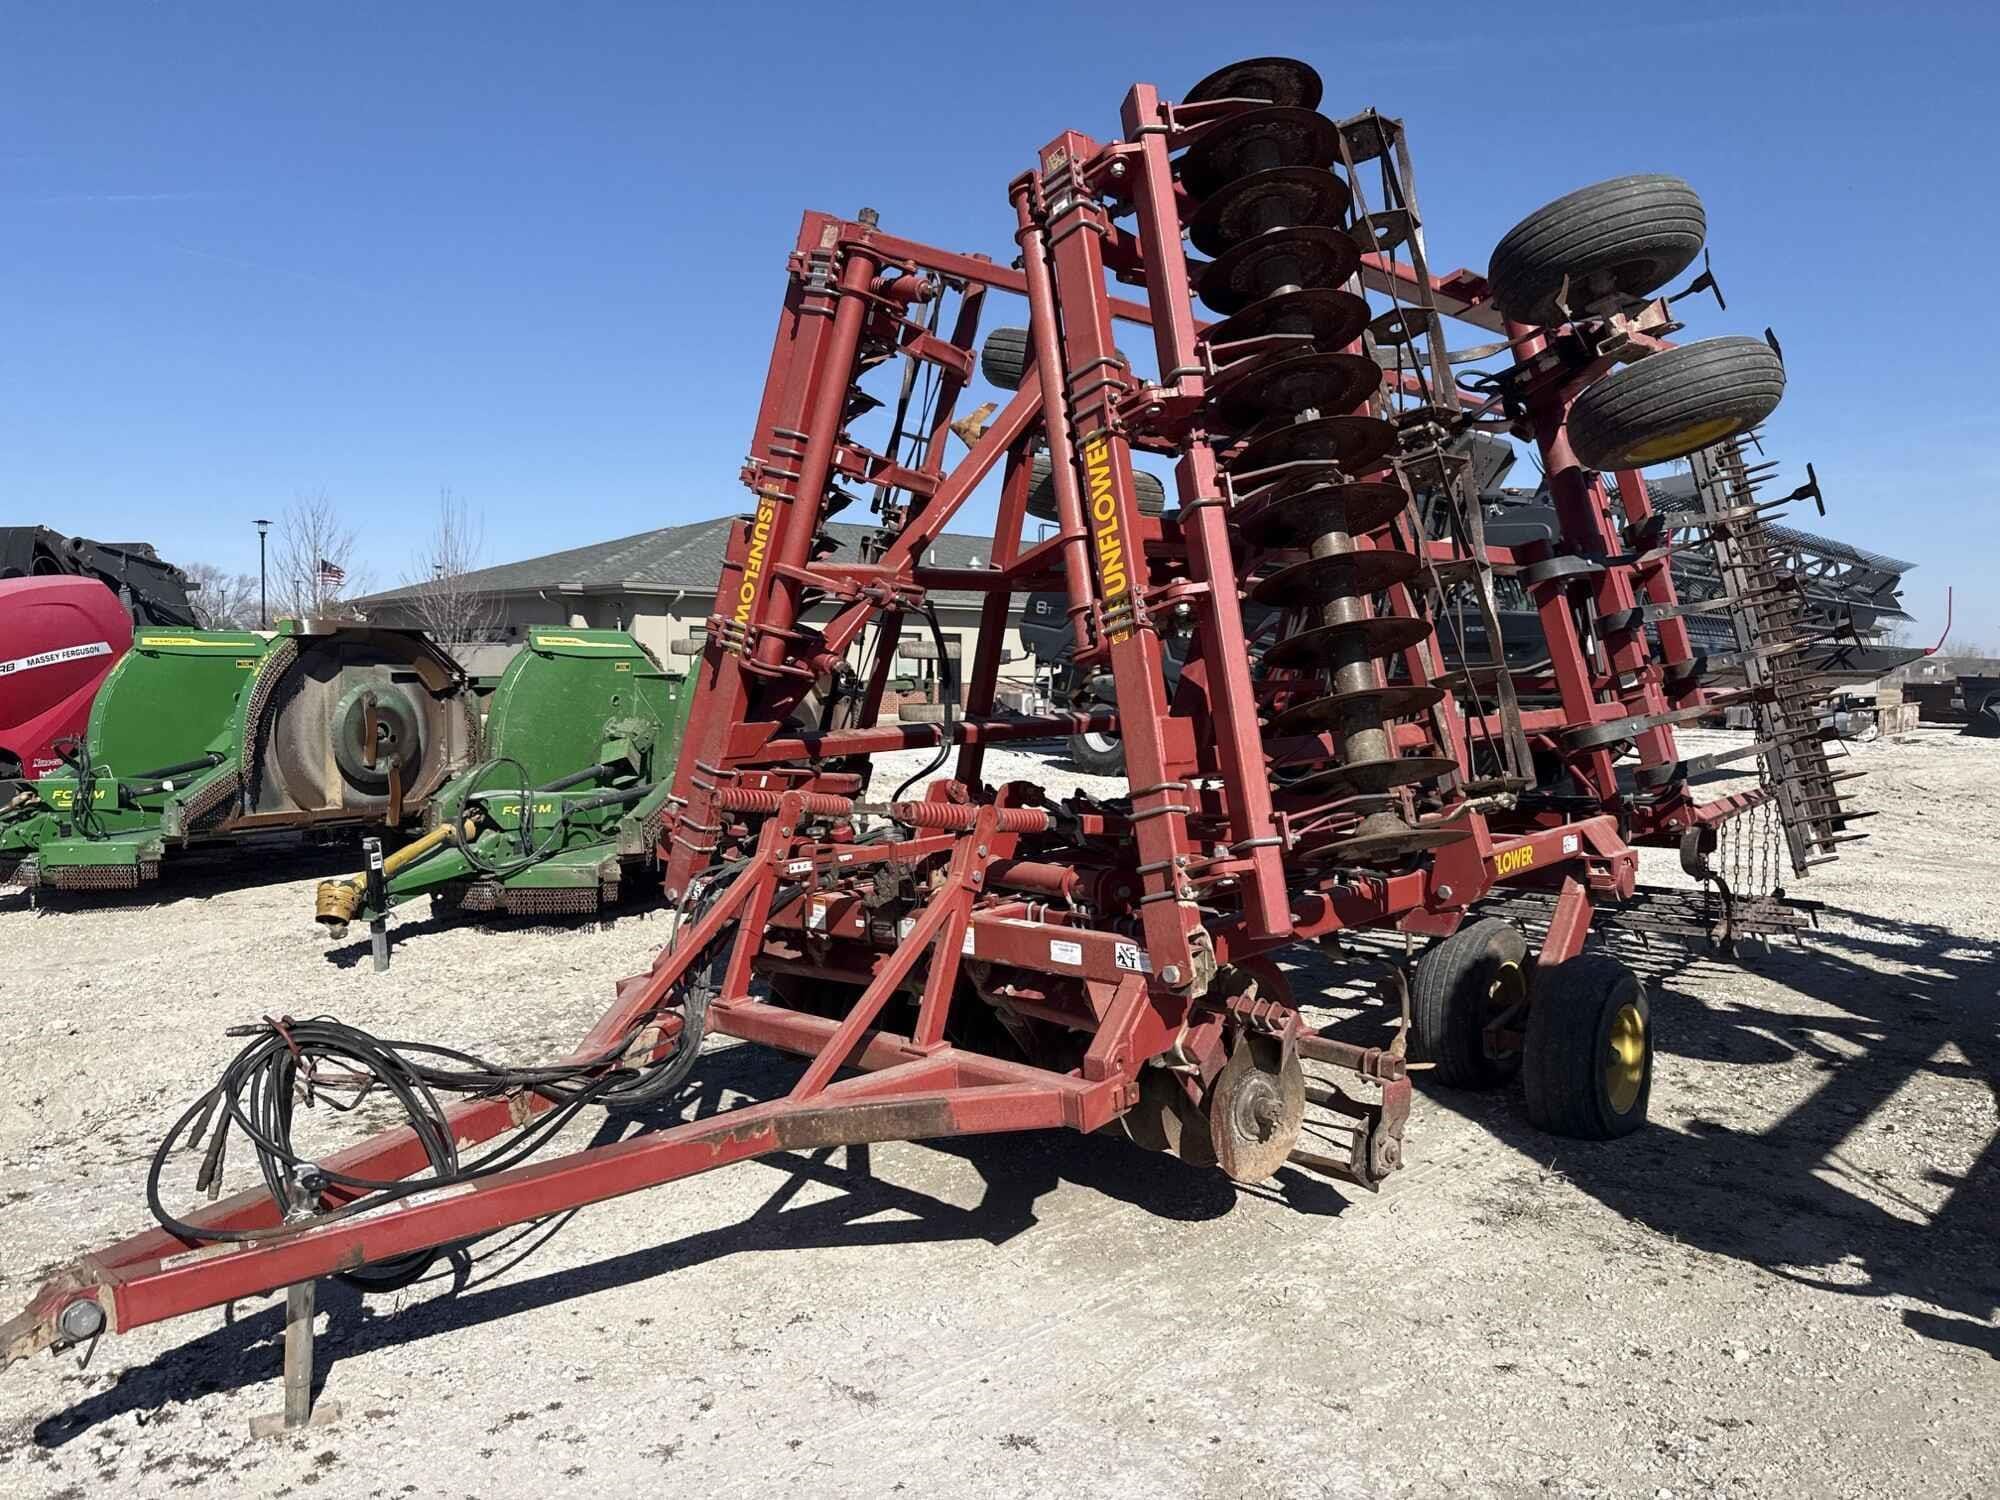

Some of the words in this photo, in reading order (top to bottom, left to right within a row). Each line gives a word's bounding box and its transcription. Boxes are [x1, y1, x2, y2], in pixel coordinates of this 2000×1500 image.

[729, 506, 774, 654] SUNFLOW
[26, 653, 60, 666] MASSEY
[62, 646, 100, 659] FERGUSON
